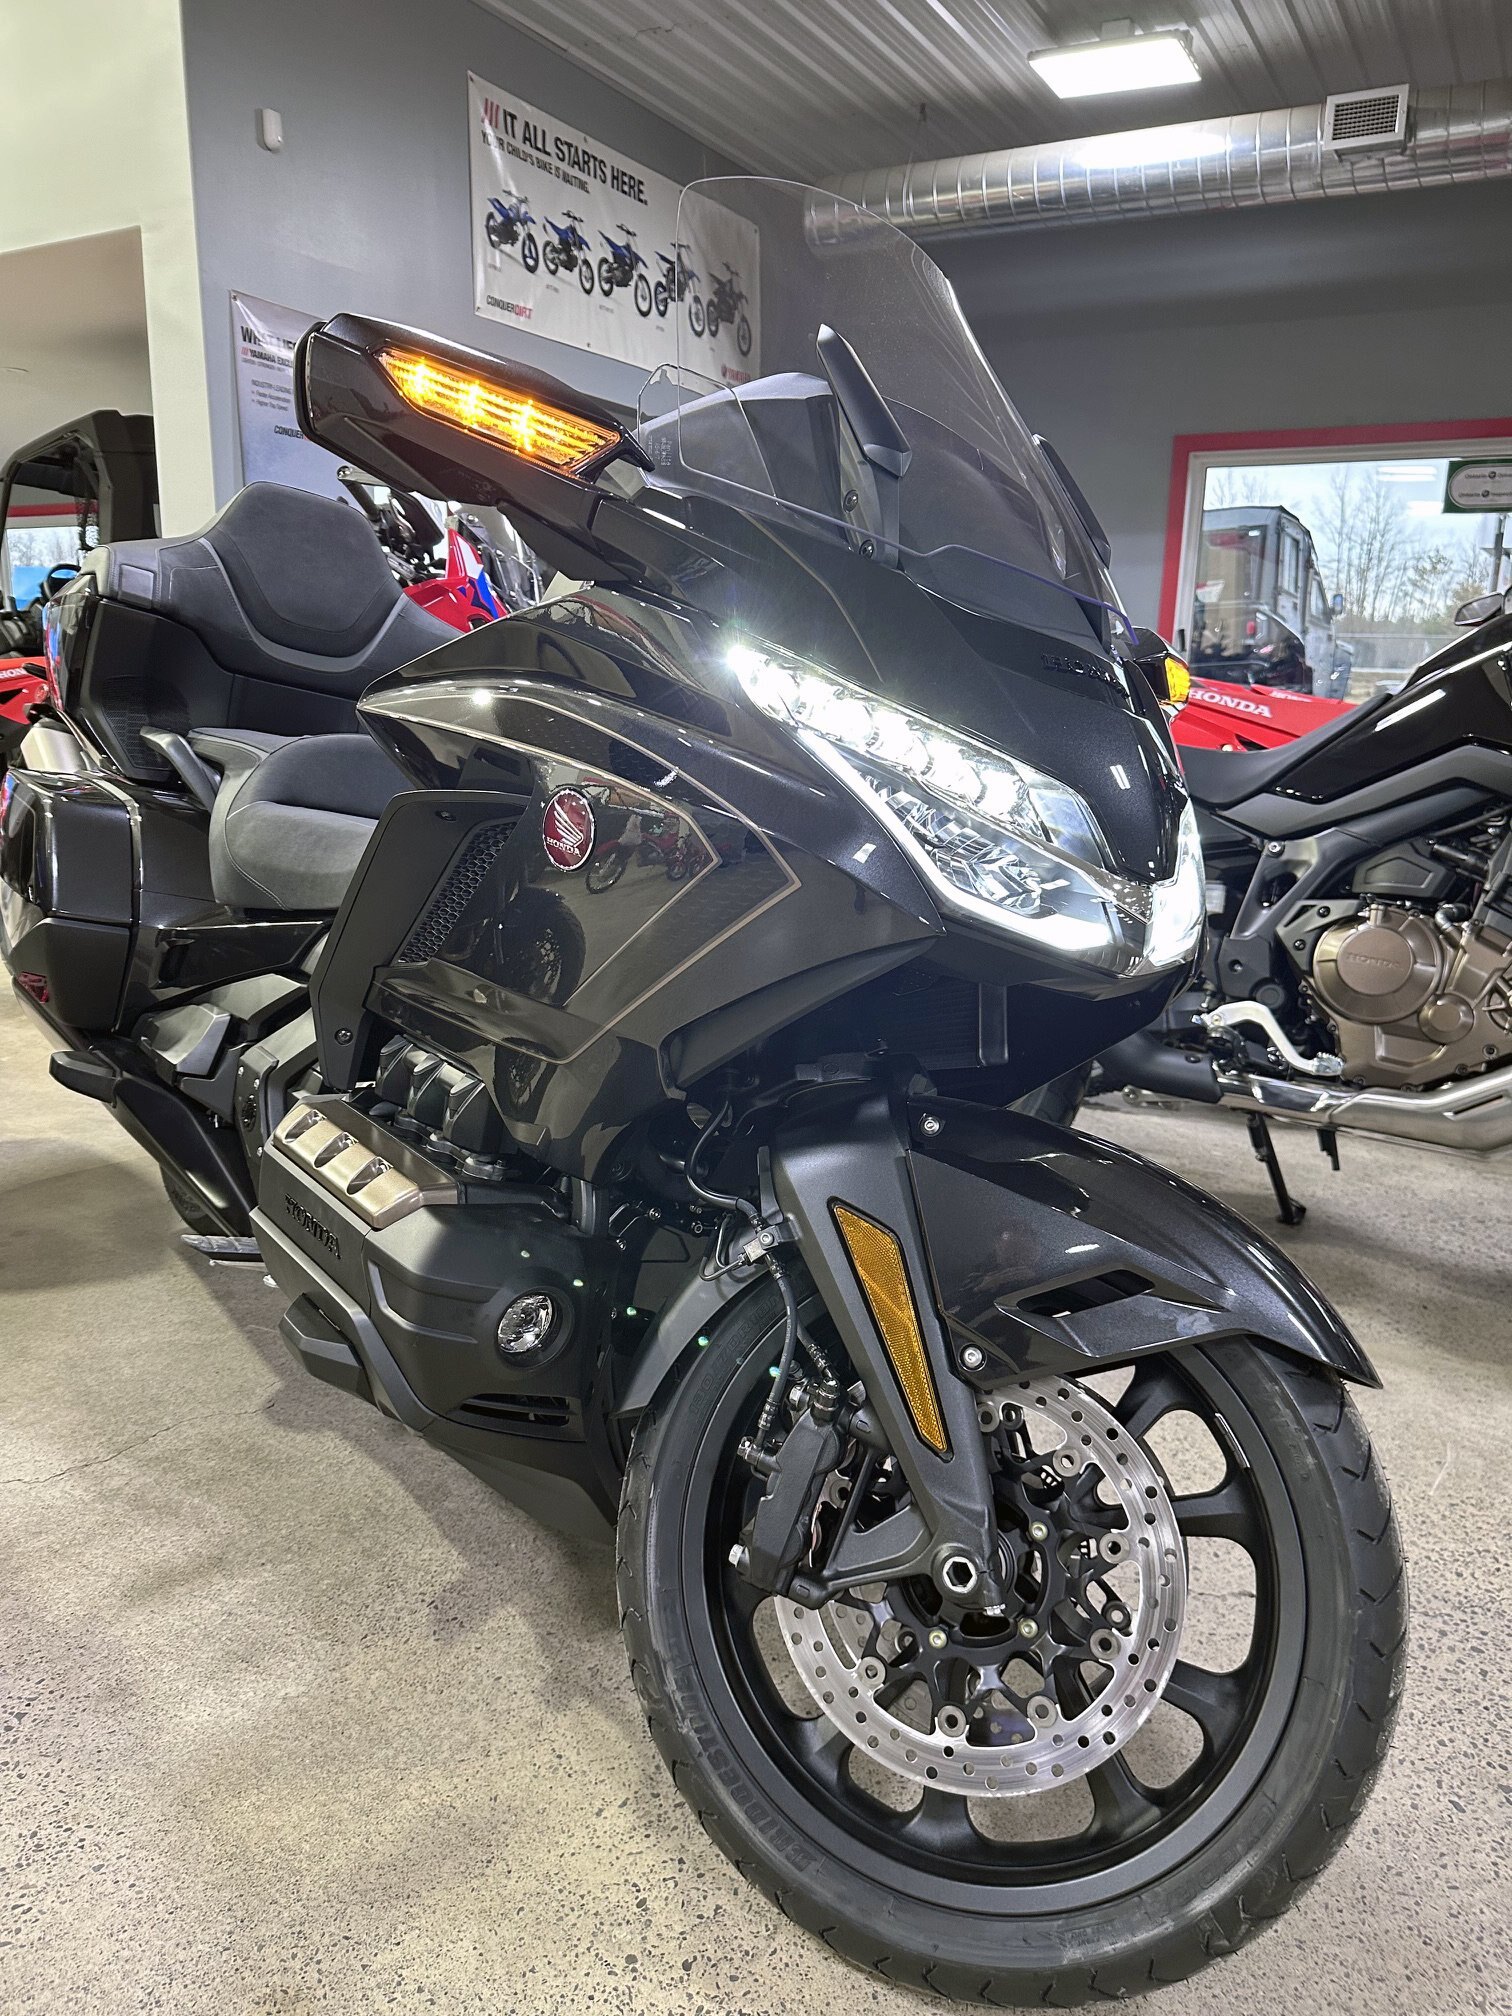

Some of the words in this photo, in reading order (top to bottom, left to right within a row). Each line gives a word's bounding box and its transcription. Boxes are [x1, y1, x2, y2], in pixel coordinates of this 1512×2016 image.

[503, 109, 517, 139] IT
[522, 120, 551, 156] ALL
[554, 136, 607, 184] STARTS
[611, 165, 648, 206] HERE.
[506, 141, 534, 166] CHILD'S
[535, 156, 553, 175] BIKE
[554, 165, 561, 179] IS
[1188, 689, 1272, 718] HONDA
[546, 836, 581, 857] HONDA
[285, 1193, 341, 1260] HONDA
